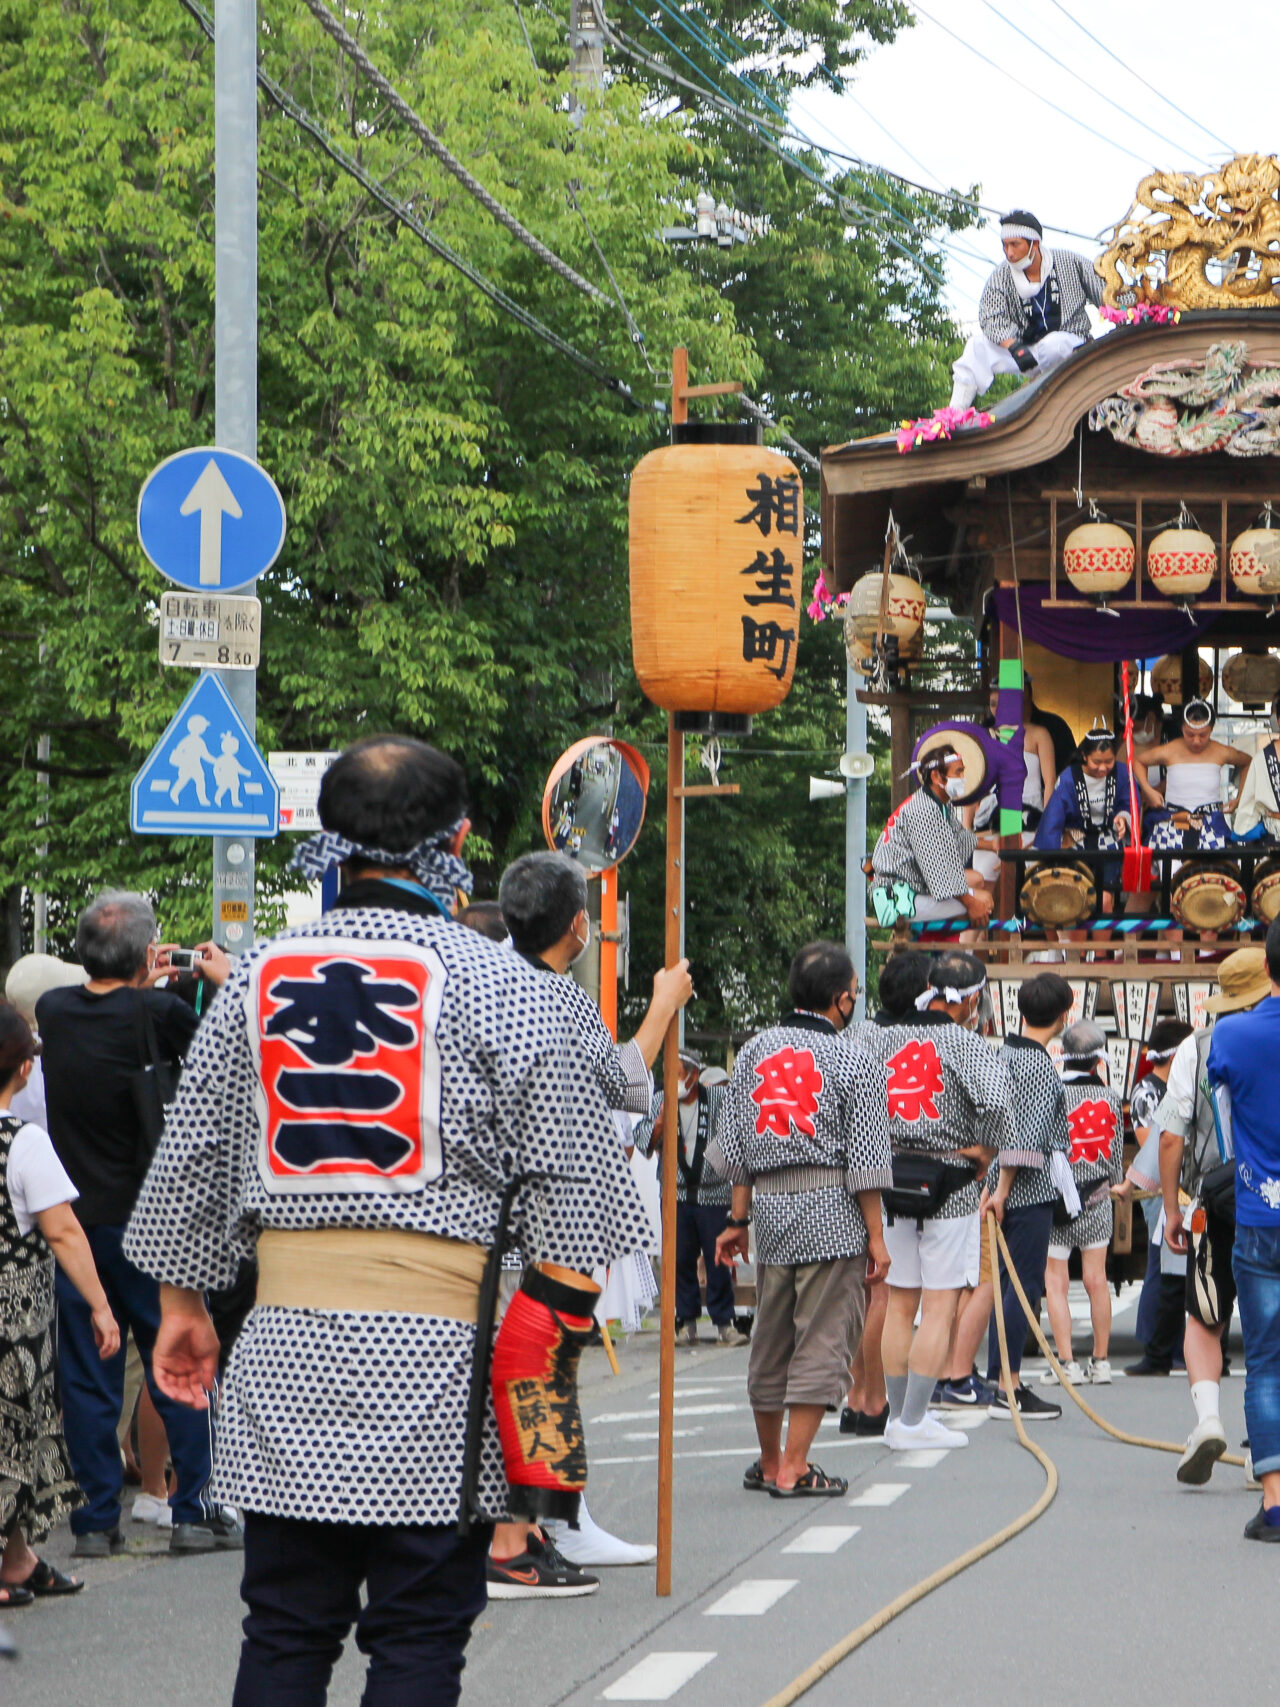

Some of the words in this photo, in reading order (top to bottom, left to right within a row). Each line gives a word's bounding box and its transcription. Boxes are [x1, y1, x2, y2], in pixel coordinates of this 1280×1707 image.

[166, 597, 217, 619] 自転車
[734, 472, 801, 681] 相生町
[224, 612, 255, 632] を除く
[1130, 984, 1144, 1025] 相生町
[751, 1044, 825, 1139] 祭
[886, 1038, 945, 1122] 祭
[1112, 1045, 1126, 1085] 相生町
[1068, 1098, 1118, 1164] 祭
[514, 1380, 557, 1459] 世話人
